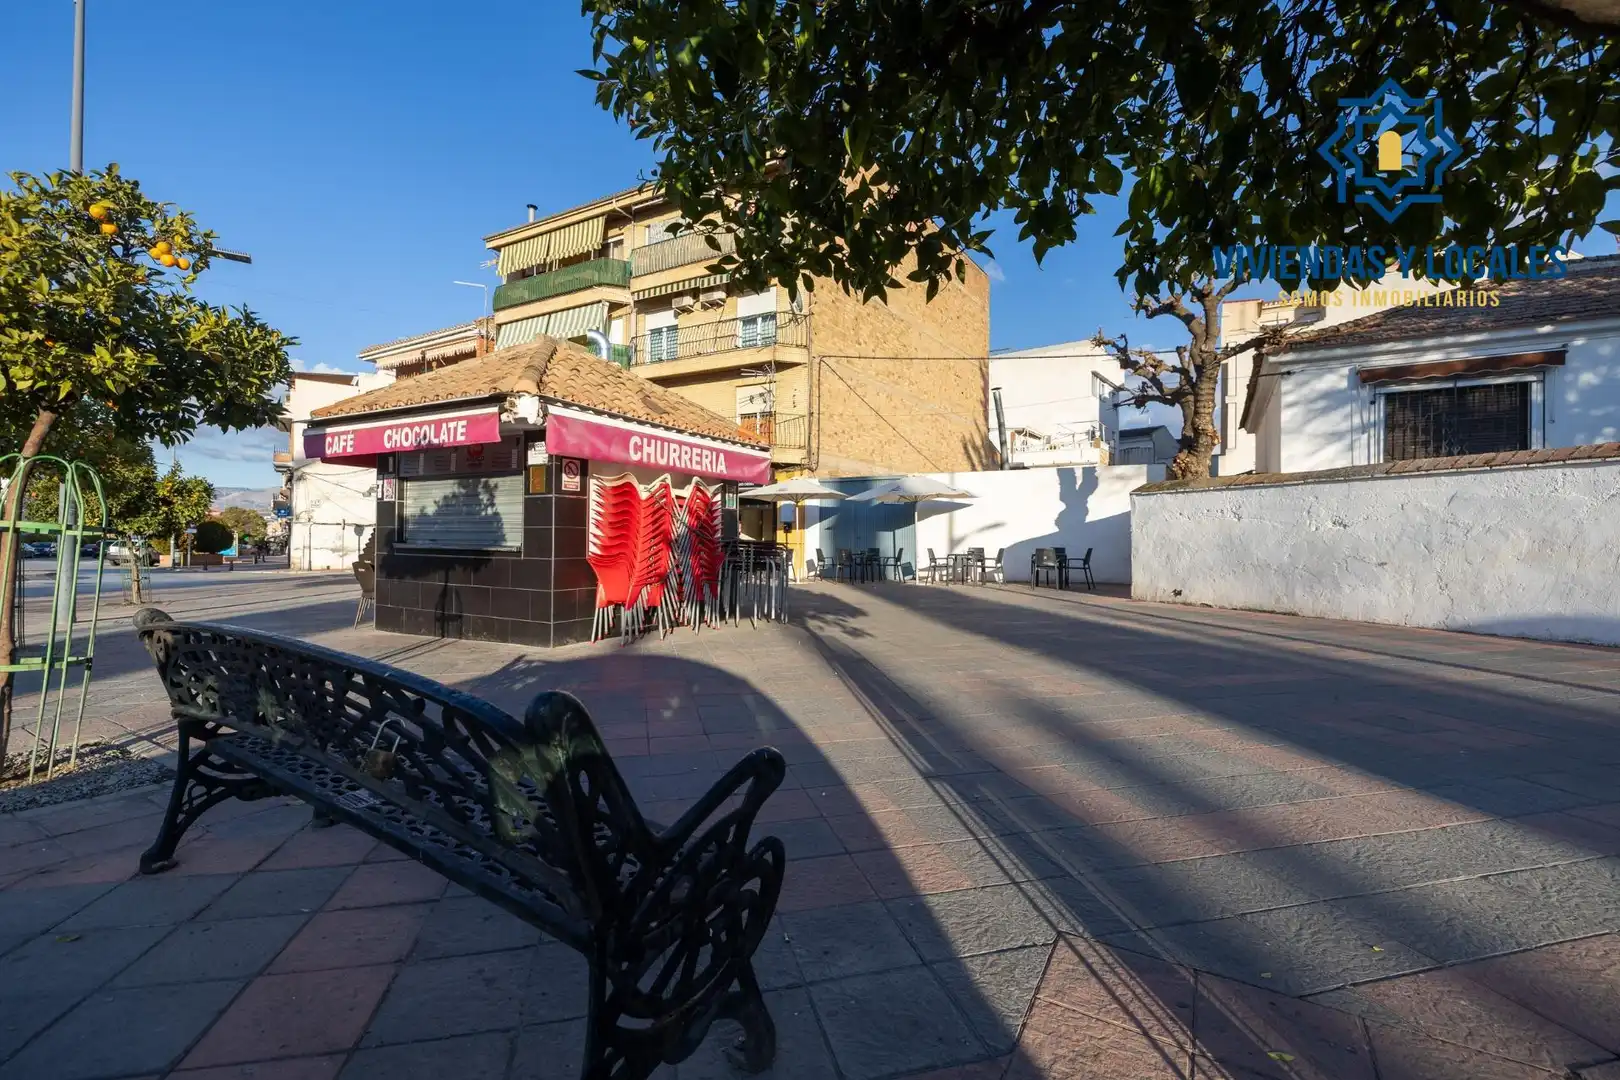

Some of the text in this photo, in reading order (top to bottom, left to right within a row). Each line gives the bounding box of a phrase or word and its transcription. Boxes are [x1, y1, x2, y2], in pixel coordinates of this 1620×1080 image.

[325, 421, 467, 455] CAFÉ CHOCOLATE
[628, 435, 727, 475] CHURRERIA
